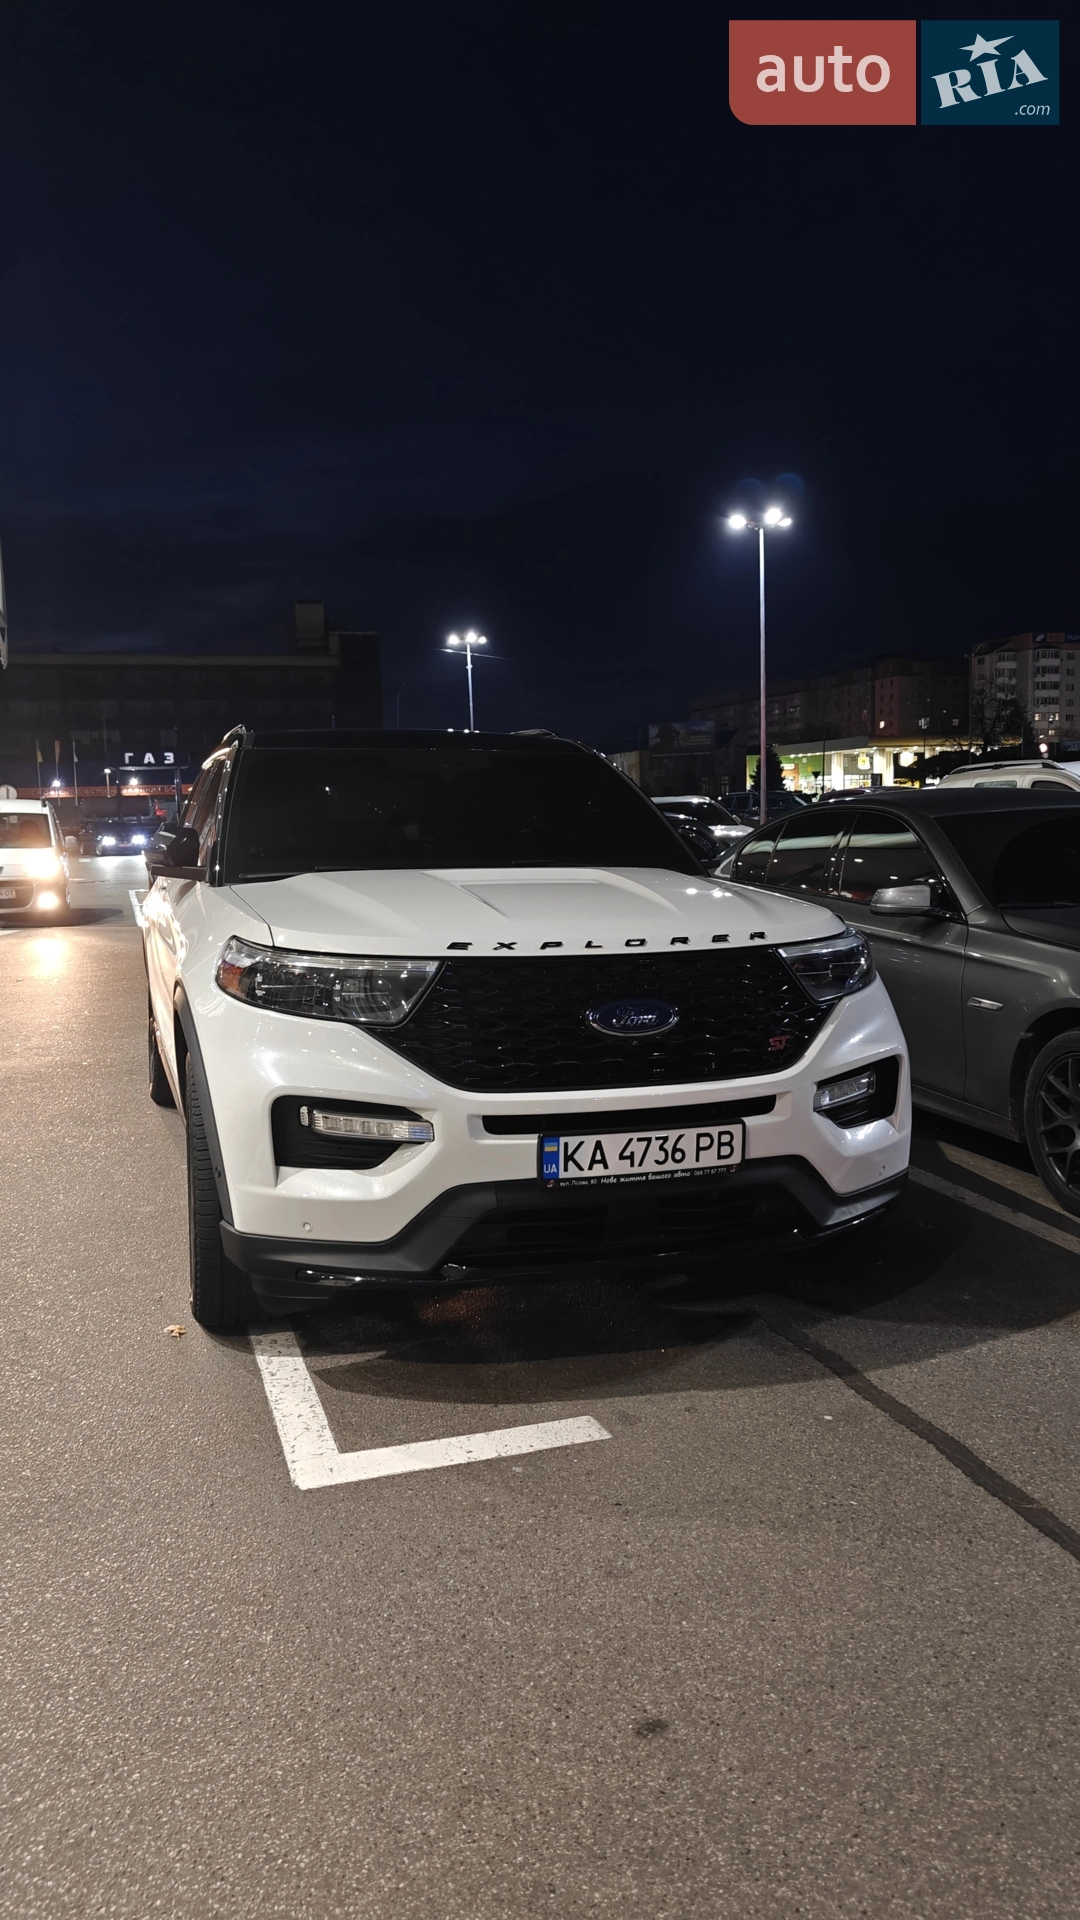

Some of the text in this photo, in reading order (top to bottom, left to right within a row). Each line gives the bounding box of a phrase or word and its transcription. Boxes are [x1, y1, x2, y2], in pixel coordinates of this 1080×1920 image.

[124, 752, 175, 765] ГАЗ
[446, 931, 767, 951] EXPLORER
[612, 1006, 660, 1028] Ford
[768, 1035, 791, 1051] ST
[618, 1134, 687, 1168] 4736
[543, 1163, 558, 1174] UA
[600, 1176, 618, 1184] Нове
[673, 1170, 691, 1178] авто
